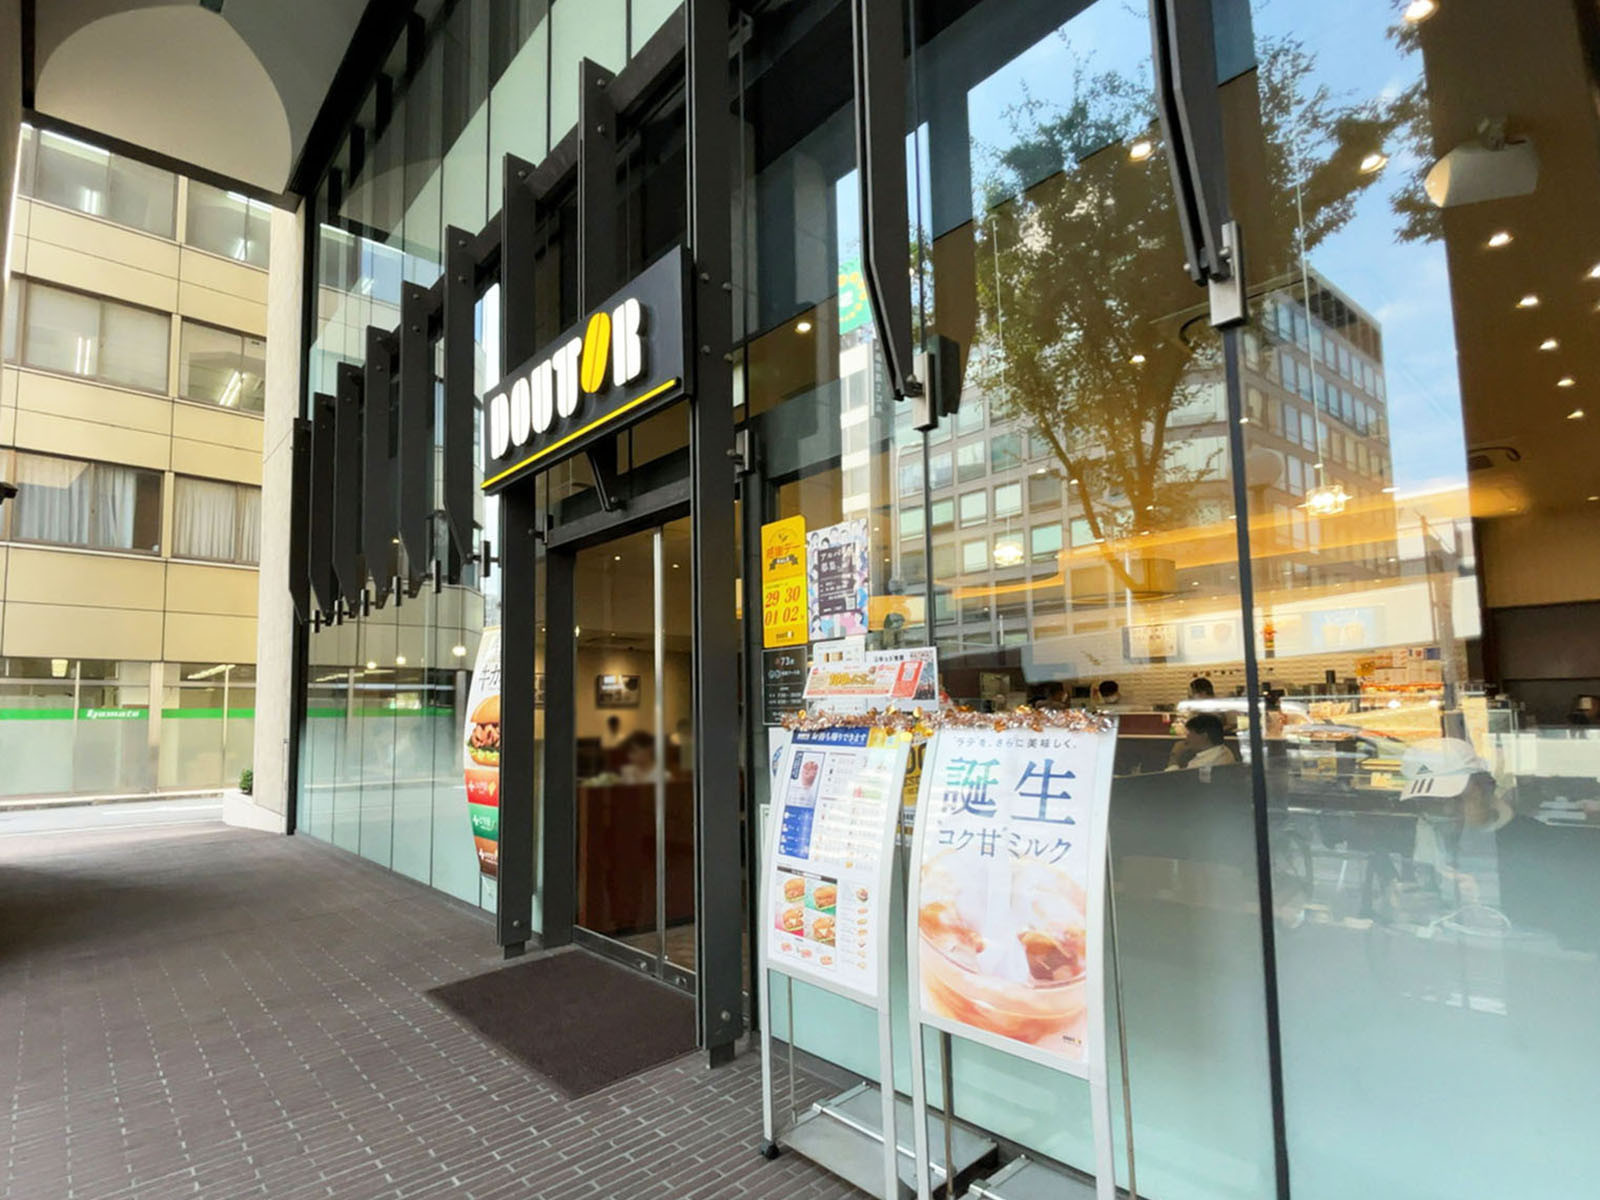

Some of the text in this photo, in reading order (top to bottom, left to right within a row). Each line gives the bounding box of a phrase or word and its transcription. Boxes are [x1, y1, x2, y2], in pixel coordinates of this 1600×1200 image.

[490, 297, 642, 461] DOUTOR
[782, 605, 799, 623] 02
[784, 585, 801, 604] 30
[941, 758, 1077, 825] 誕生
